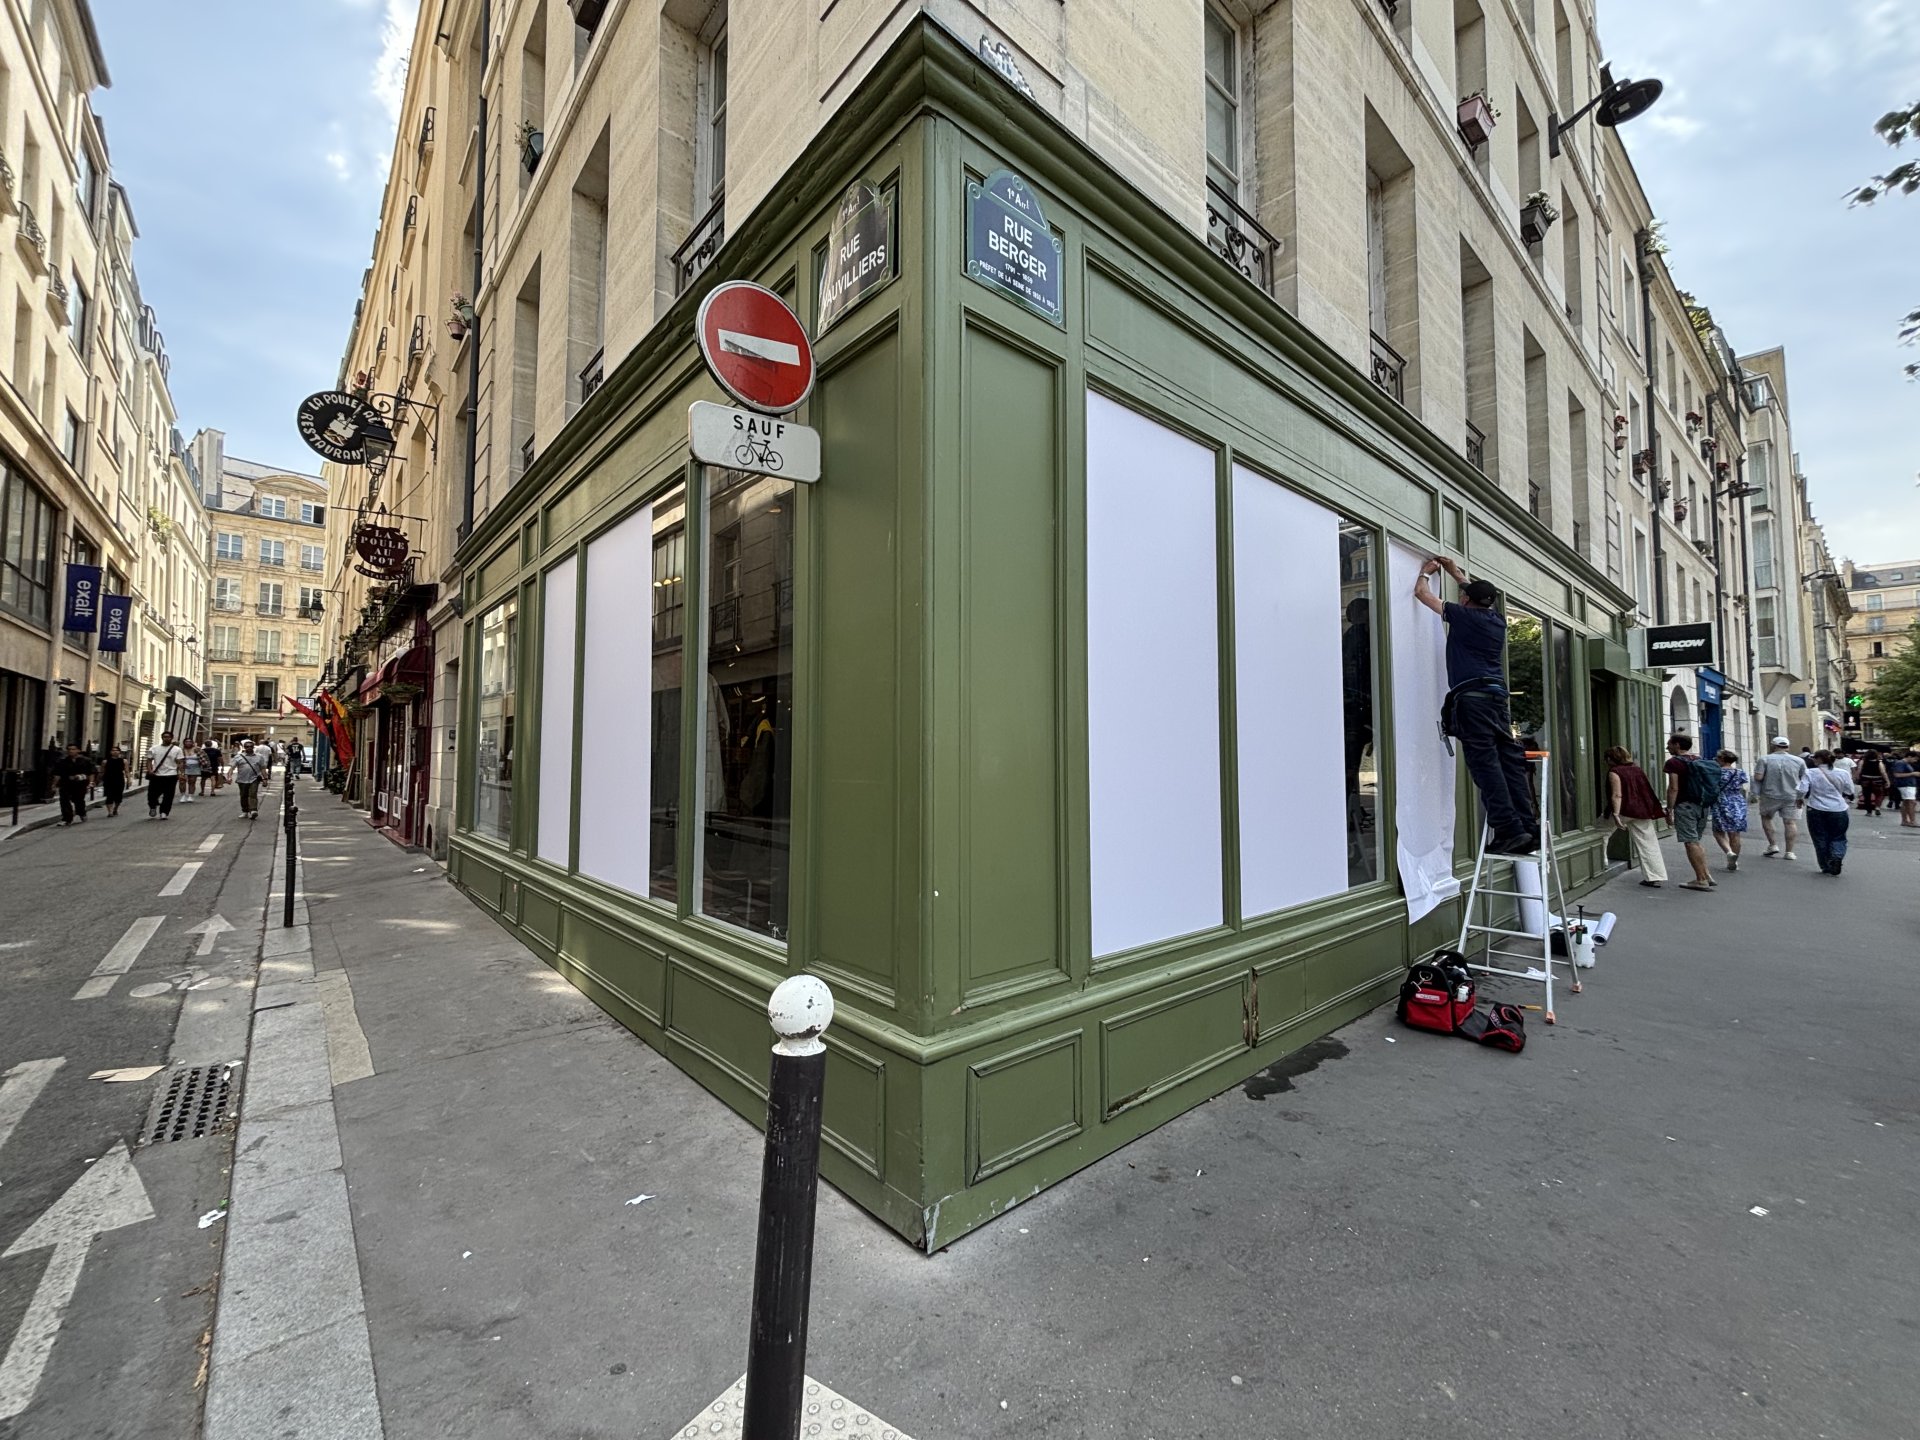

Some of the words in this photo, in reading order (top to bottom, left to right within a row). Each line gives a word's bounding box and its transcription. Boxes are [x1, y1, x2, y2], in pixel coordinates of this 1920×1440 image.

[1004, 215, 1033, 249] RUE
[840, 233, 861, 265] RUE
[988, 229, 1047, 281] BERGER
[997, 270, 1004, 280] DE
[1005, 274, 1012, 284] LA
[1025, 286, 1032, 296] DE
[307, 397, 325, 411] LA
[323, 394, 359, 409] POULE
[301, 412, 364, 460] RESTAURAN
[733, 414, 785, 439] SAUF
[360, 536, 405, 550] POULE
[375, 530, 392, 539] LA
[370, 555, 395, 565] POT
[374, 548, 391, 556] AU
[74, 580, 94, 617] exalt
[107, 608, 125, 639] exalt
[1651, 638, 1706, 650] STARCOW
